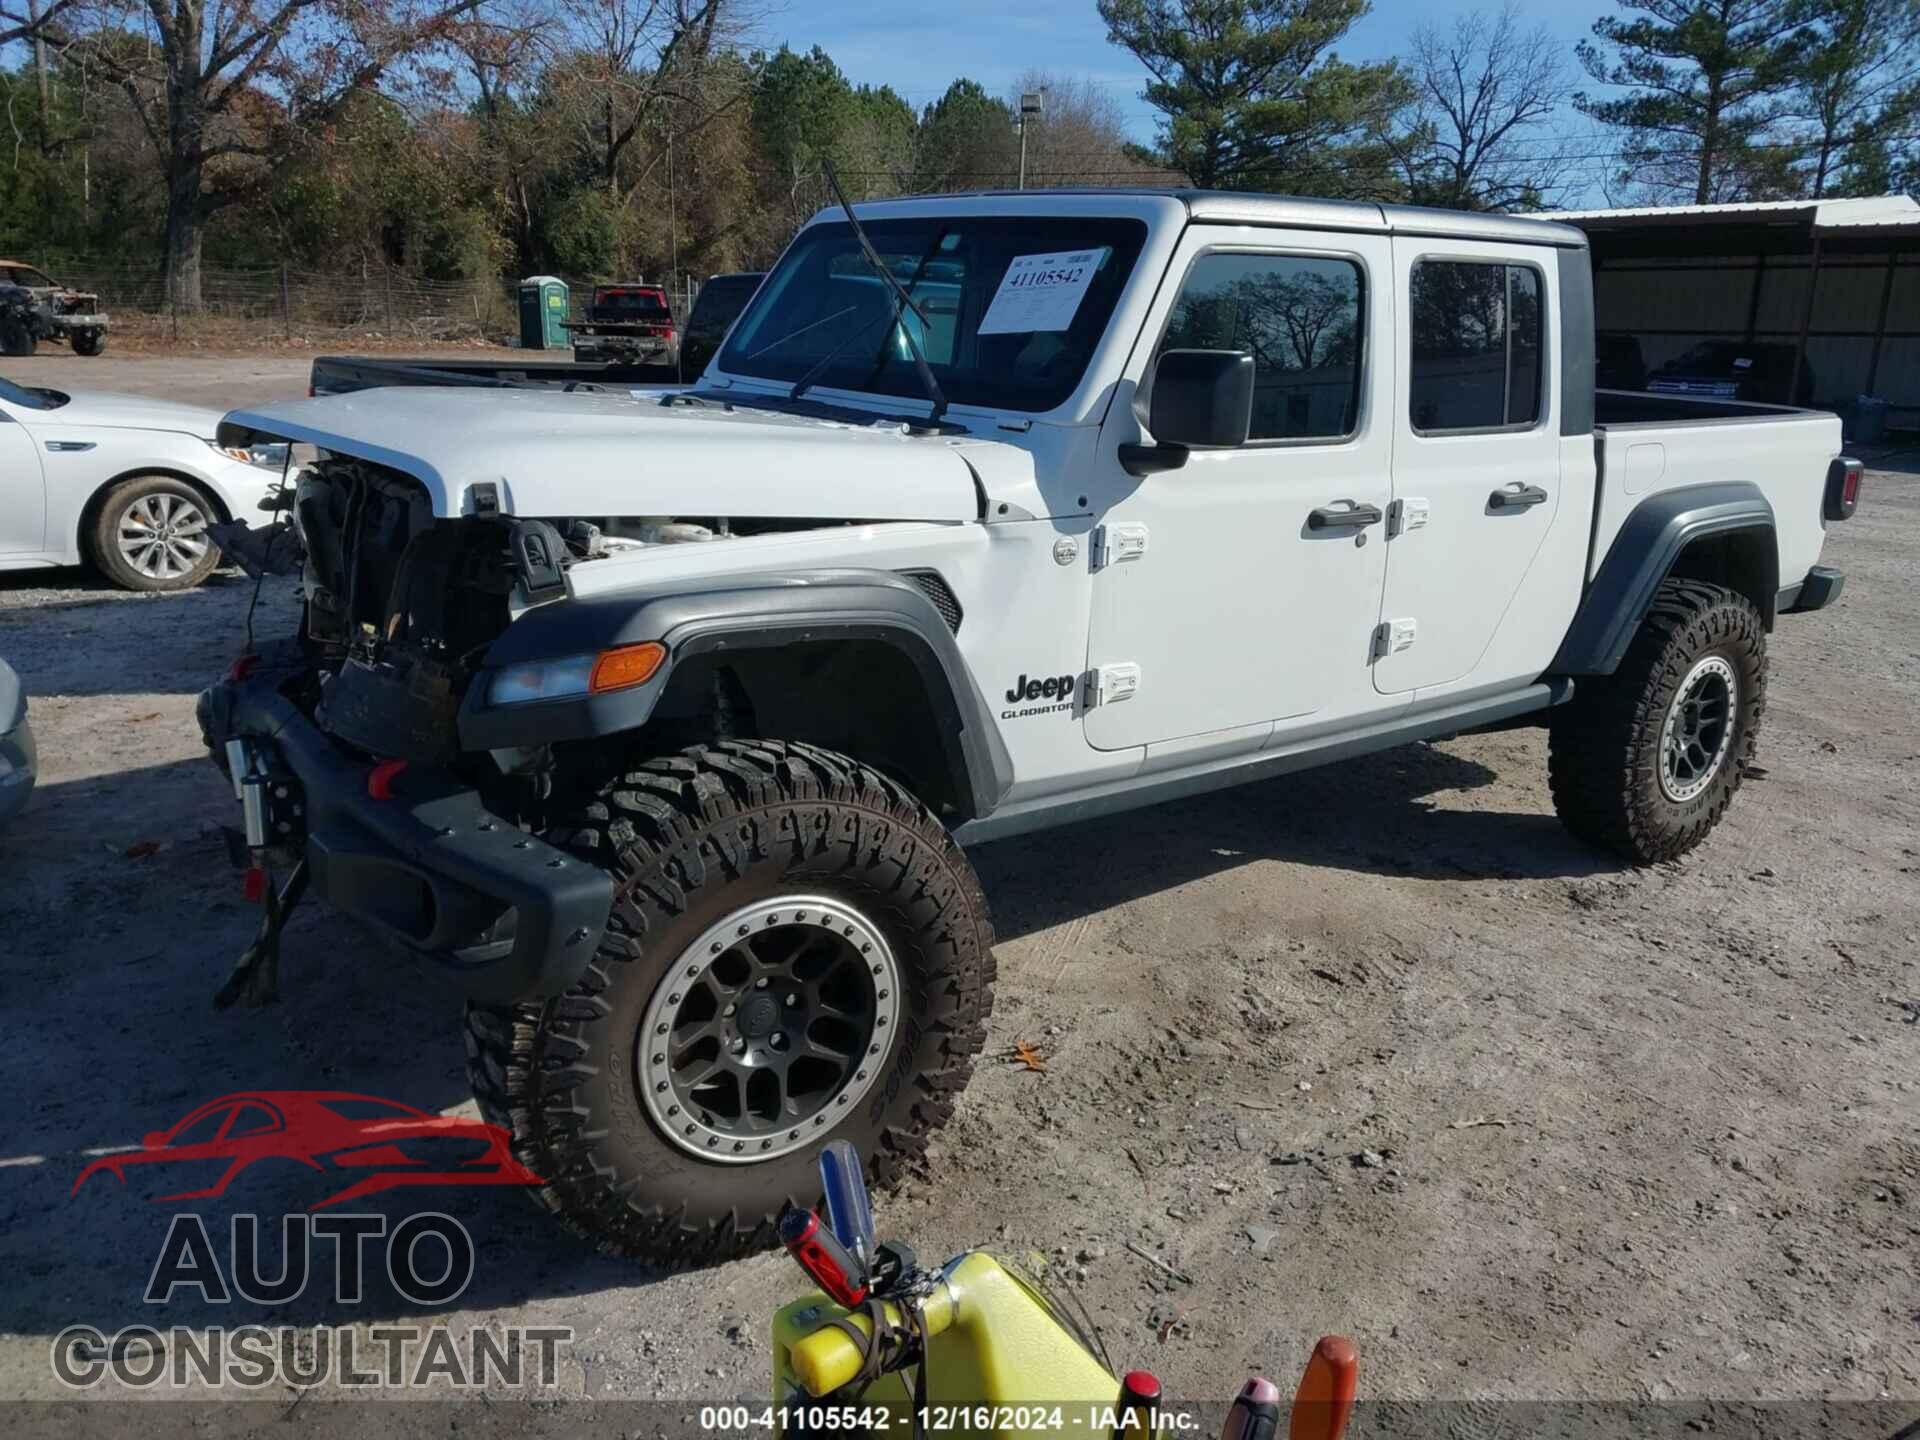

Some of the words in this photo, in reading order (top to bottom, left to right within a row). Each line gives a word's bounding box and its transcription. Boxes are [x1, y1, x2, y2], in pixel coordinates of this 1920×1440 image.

[1009, 267, 1083, 287] 41105542
[1006, 674, 1074, 703] Jeep
[1001, 702, 1074, 720] GLADIATOR
